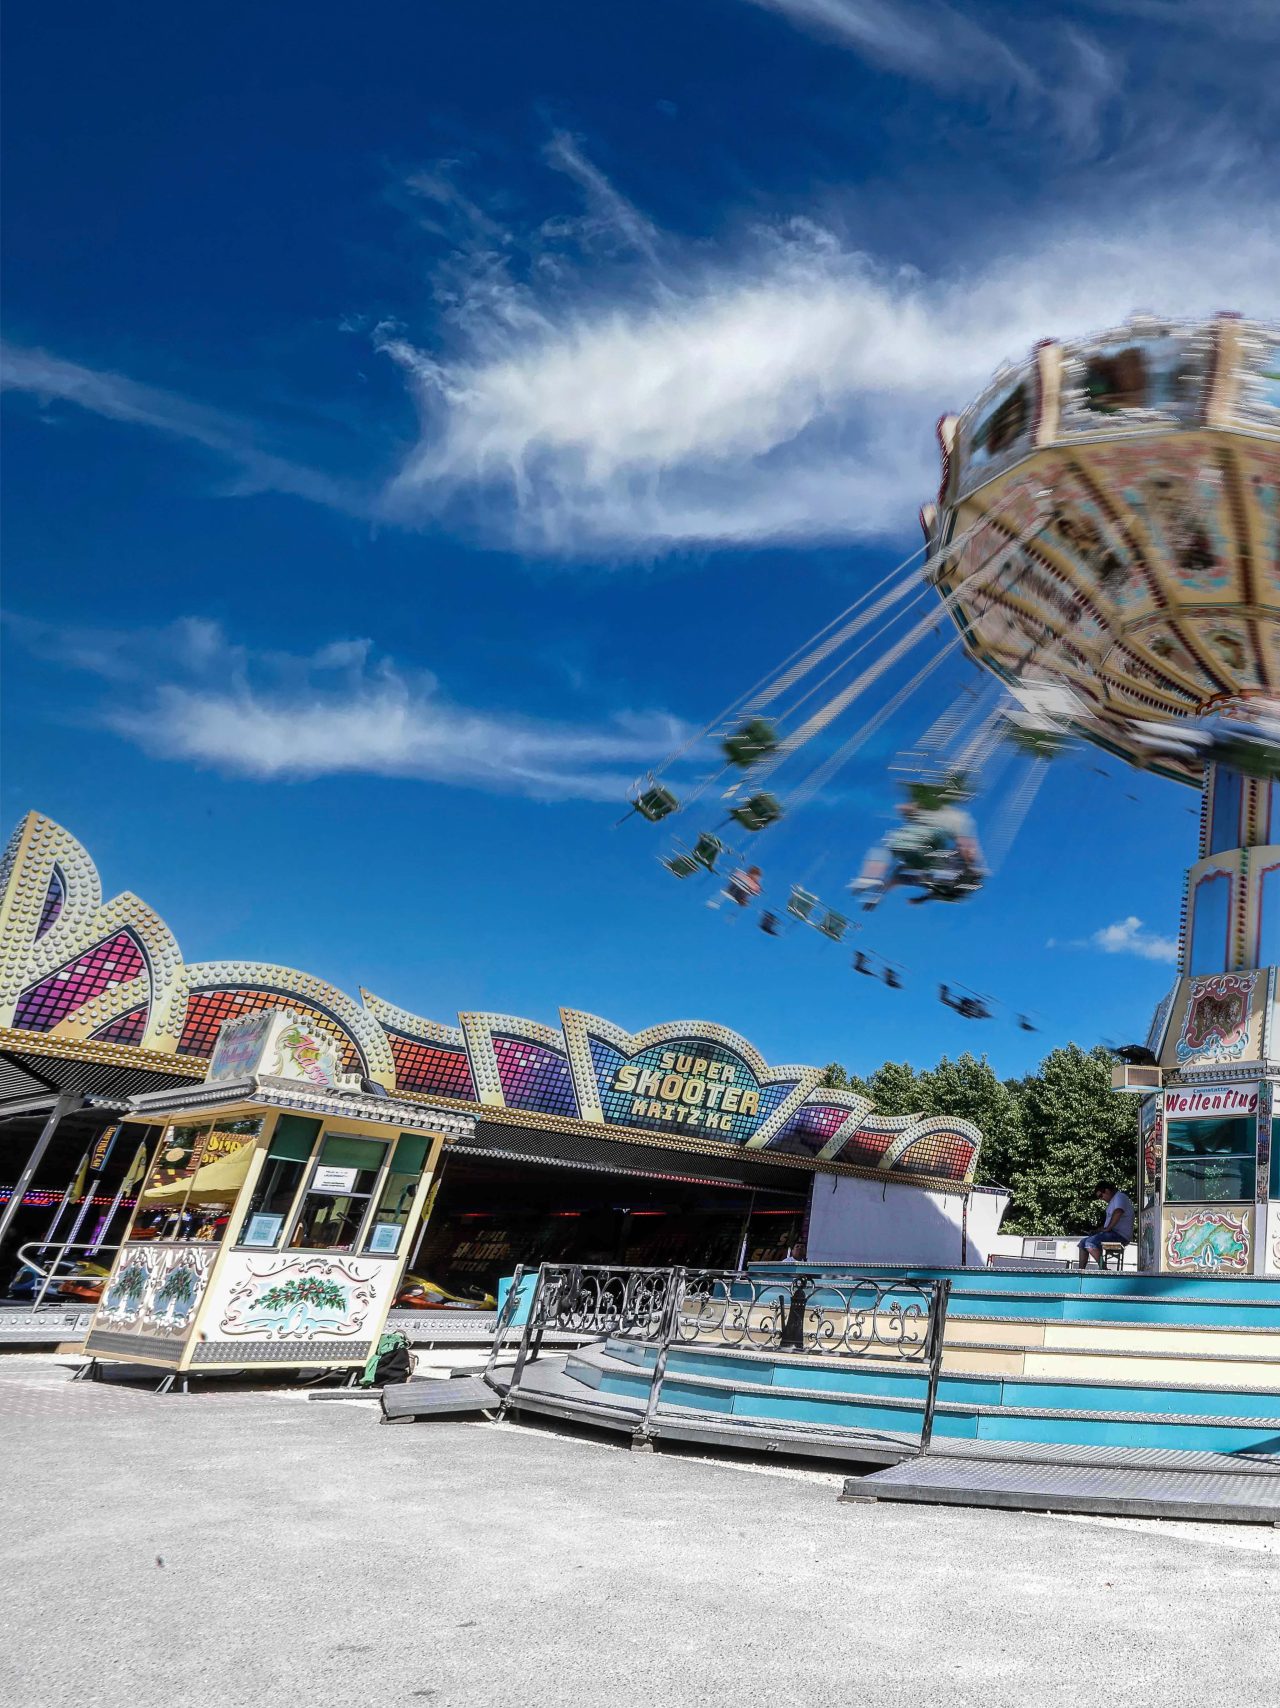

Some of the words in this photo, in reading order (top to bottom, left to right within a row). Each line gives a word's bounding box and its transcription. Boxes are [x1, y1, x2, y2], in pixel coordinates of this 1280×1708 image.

[661, 1052, 736, 1082] SUPER
[614, 1065, 759, 1117] SKOOTER
[1166, 1090, 1258, 1112] Wellenflug
[705, 1112, 733, 1131] KG
